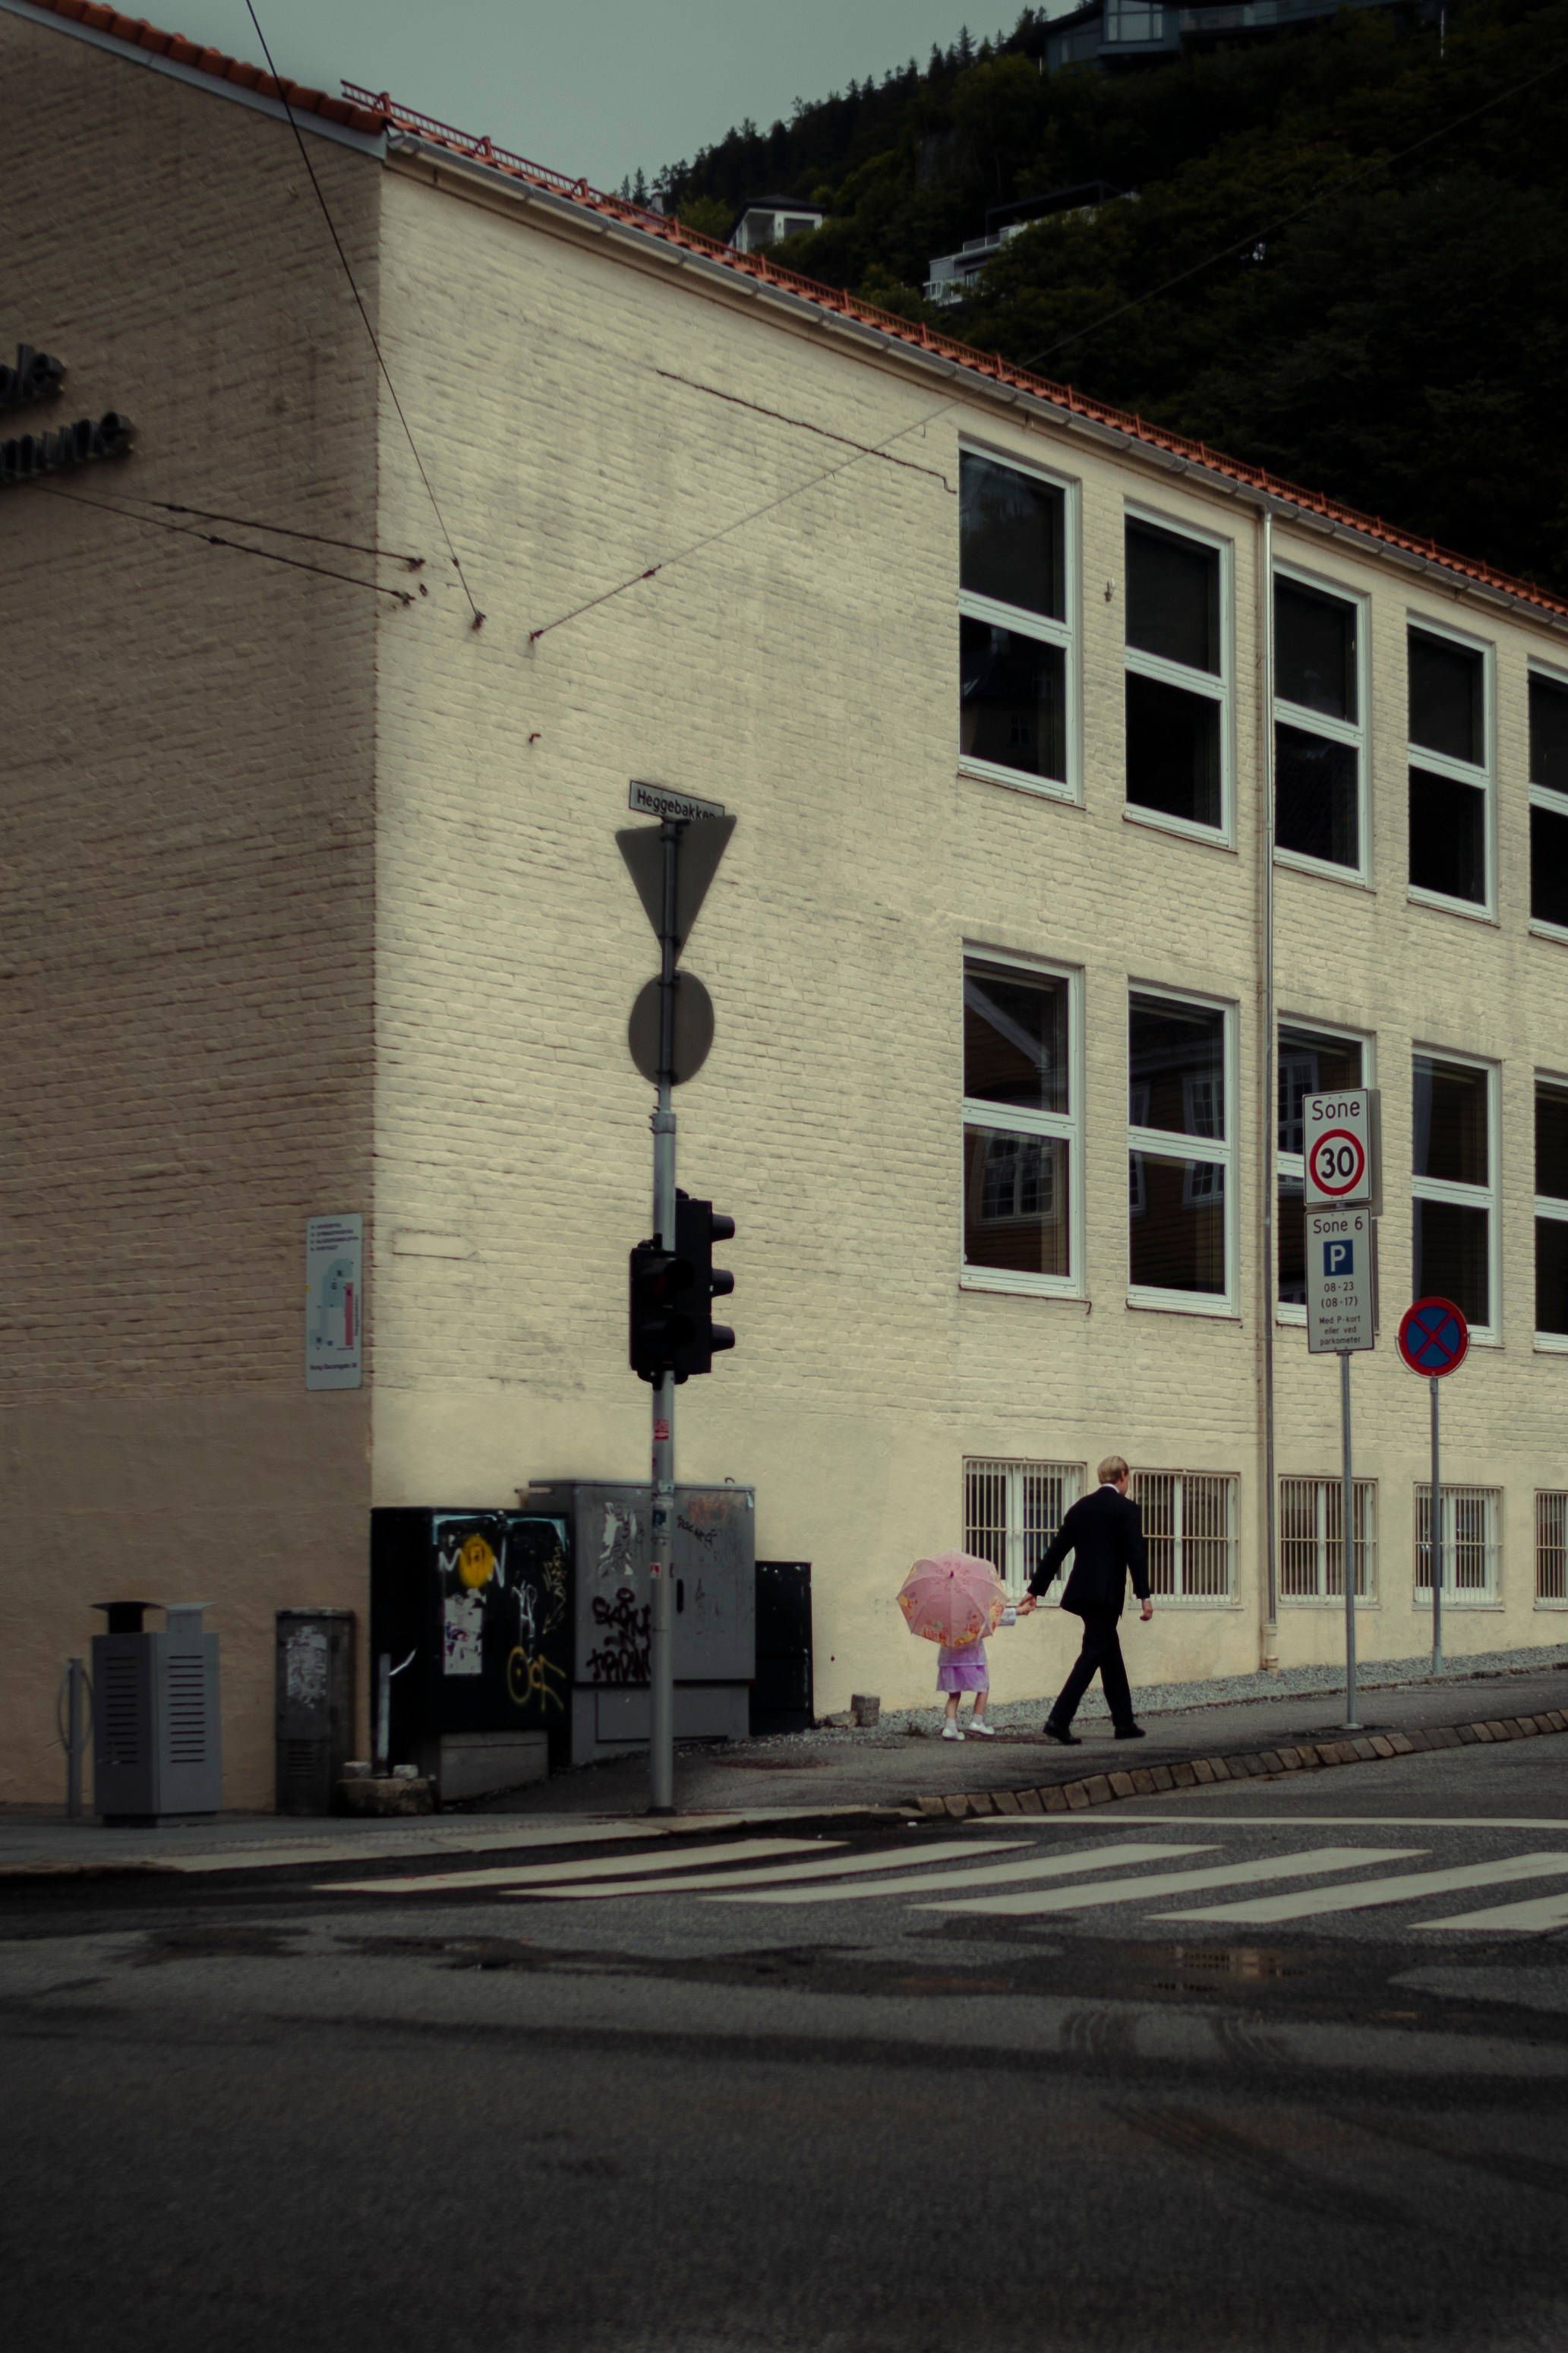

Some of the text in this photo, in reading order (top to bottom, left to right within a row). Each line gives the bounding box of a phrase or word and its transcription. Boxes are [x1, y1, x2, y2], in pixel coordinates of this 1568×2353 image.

[1312, 1100, 1360, 1120] Sone
[1320, 1145, 1354, 1179] 30
[1313, 1216, 1363, 1233] Sone 6
[1330, 1245, 1346, 1272] P
[1319, 1315, 1361, 1325] Med P-kort
[1320, 1336, 1361, 1347] parkometer
